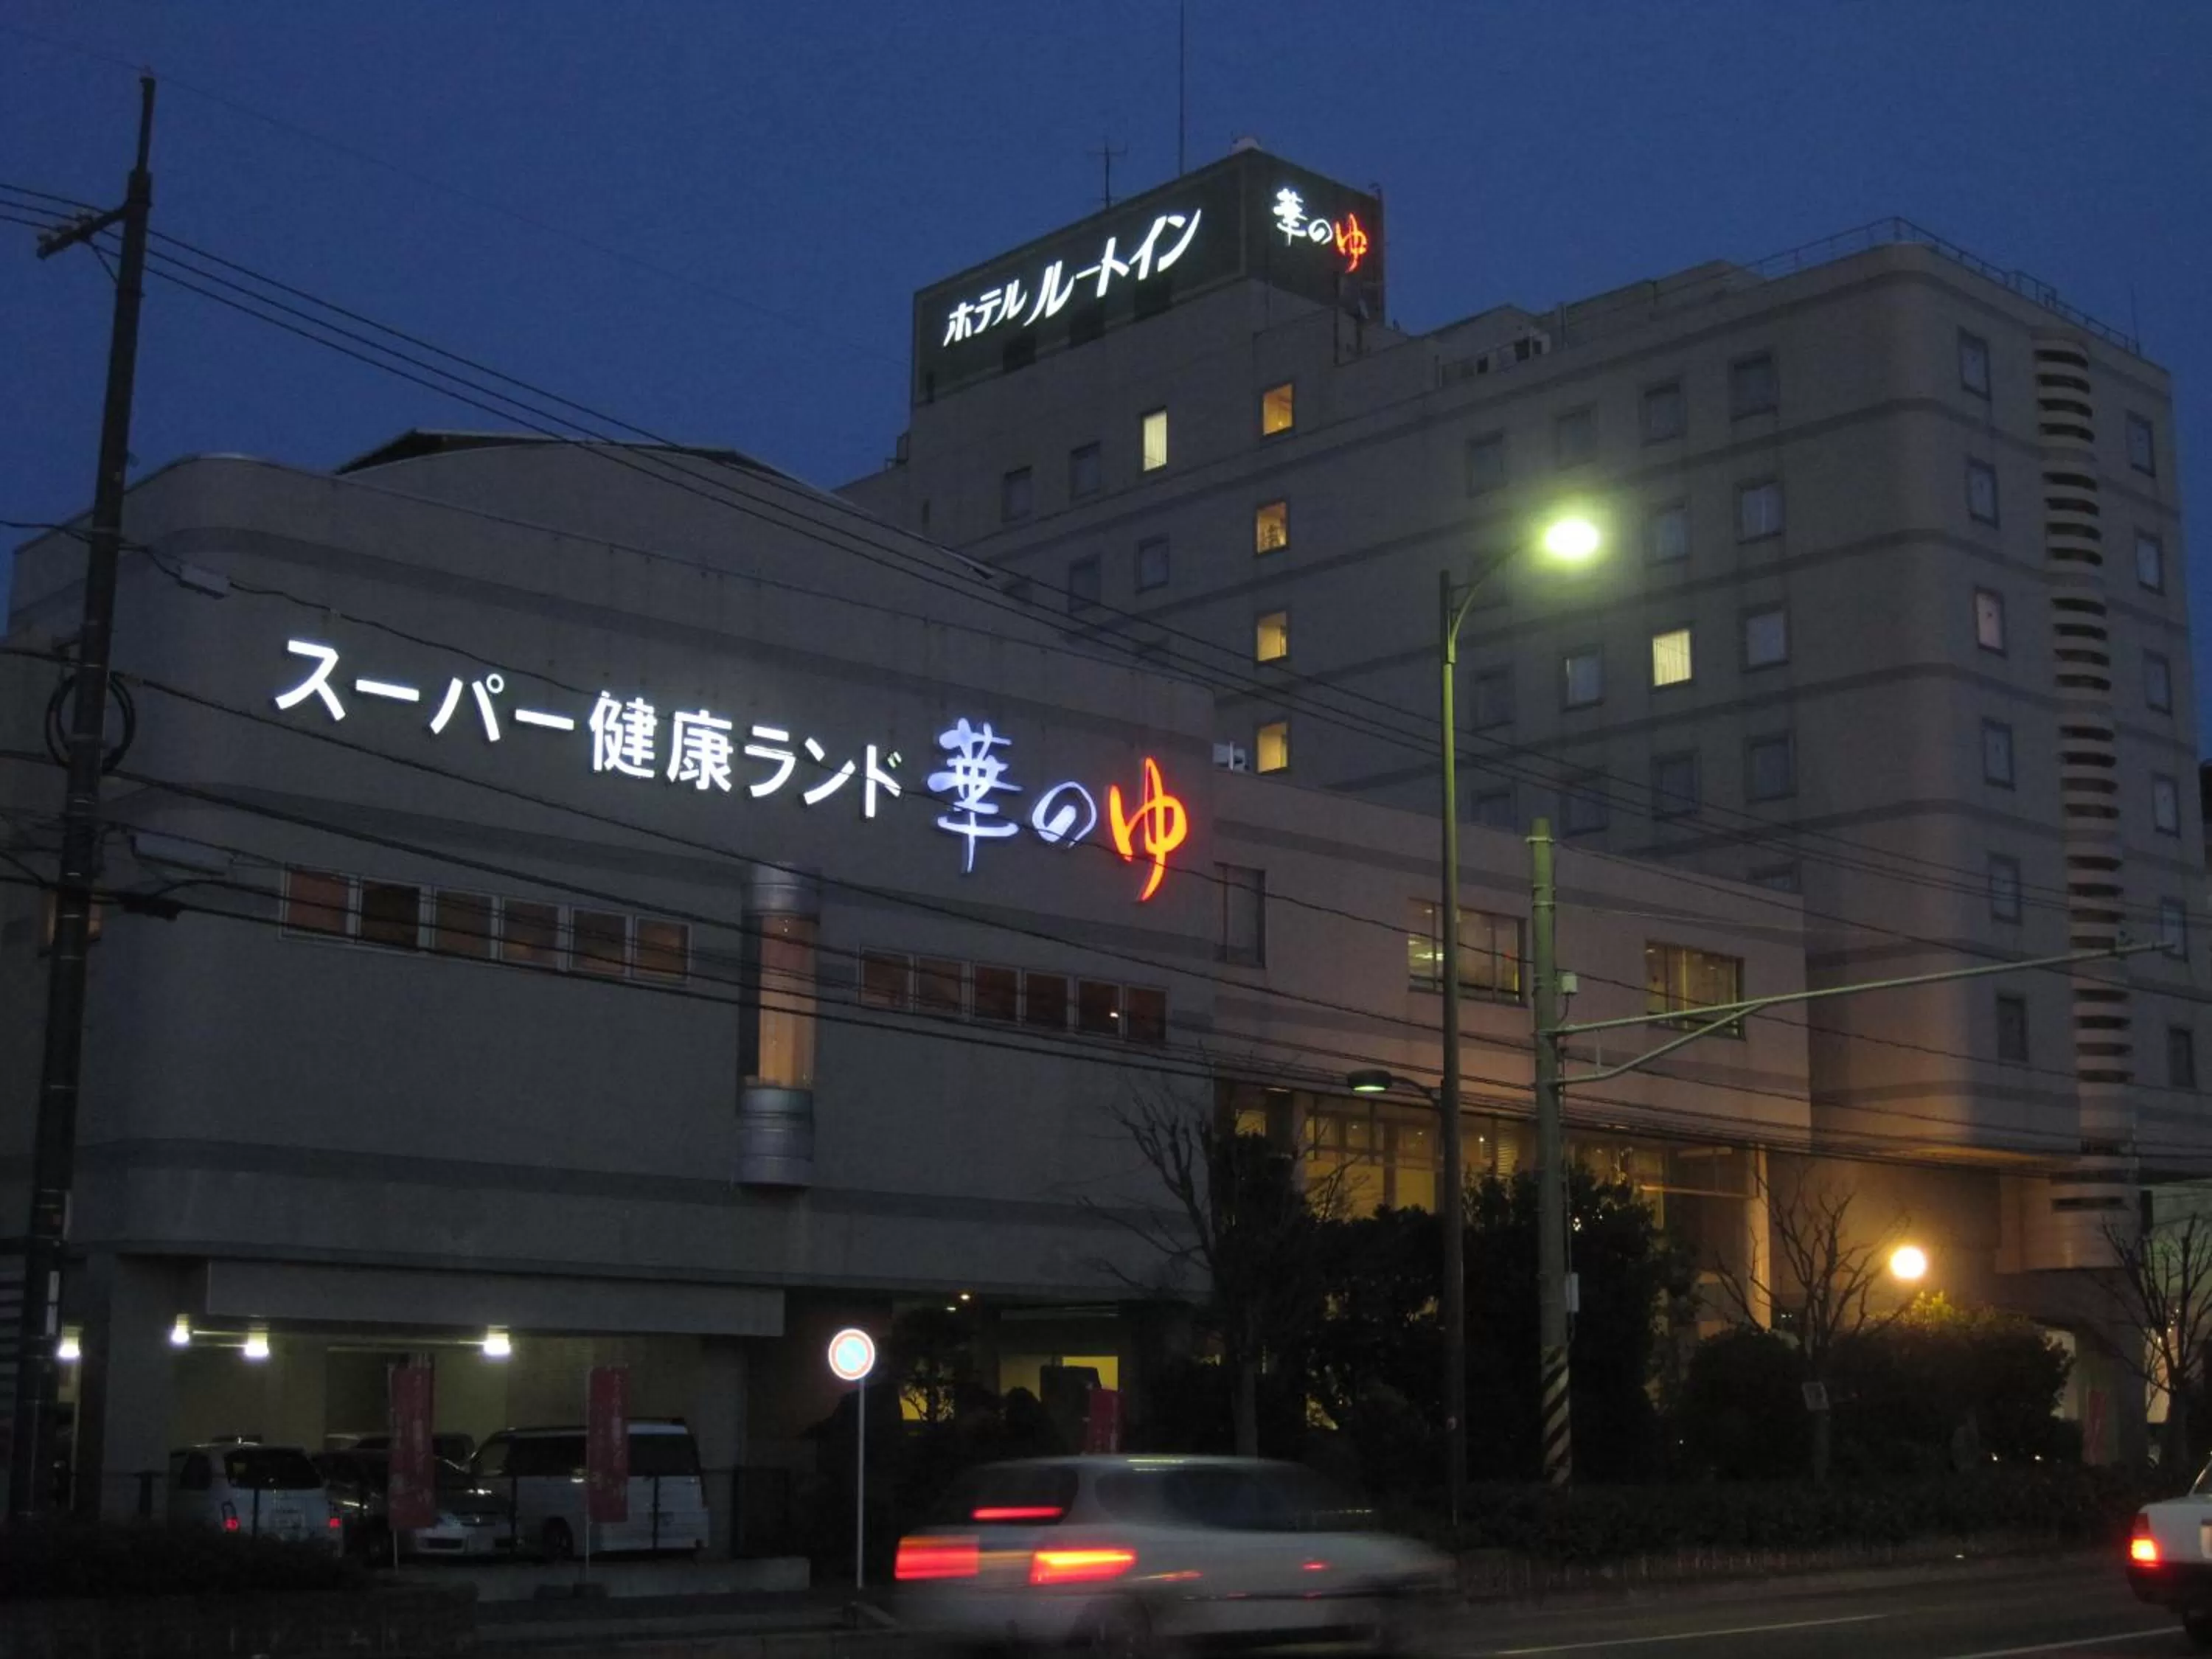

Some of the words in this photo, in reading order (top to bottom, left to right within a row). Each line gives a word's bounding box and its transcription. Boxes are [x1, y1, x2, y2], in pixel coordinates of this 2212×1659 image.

[1272, 187, 1369, 272] 華のゆ
[926, 716, 1190, 902] 華のゆ
